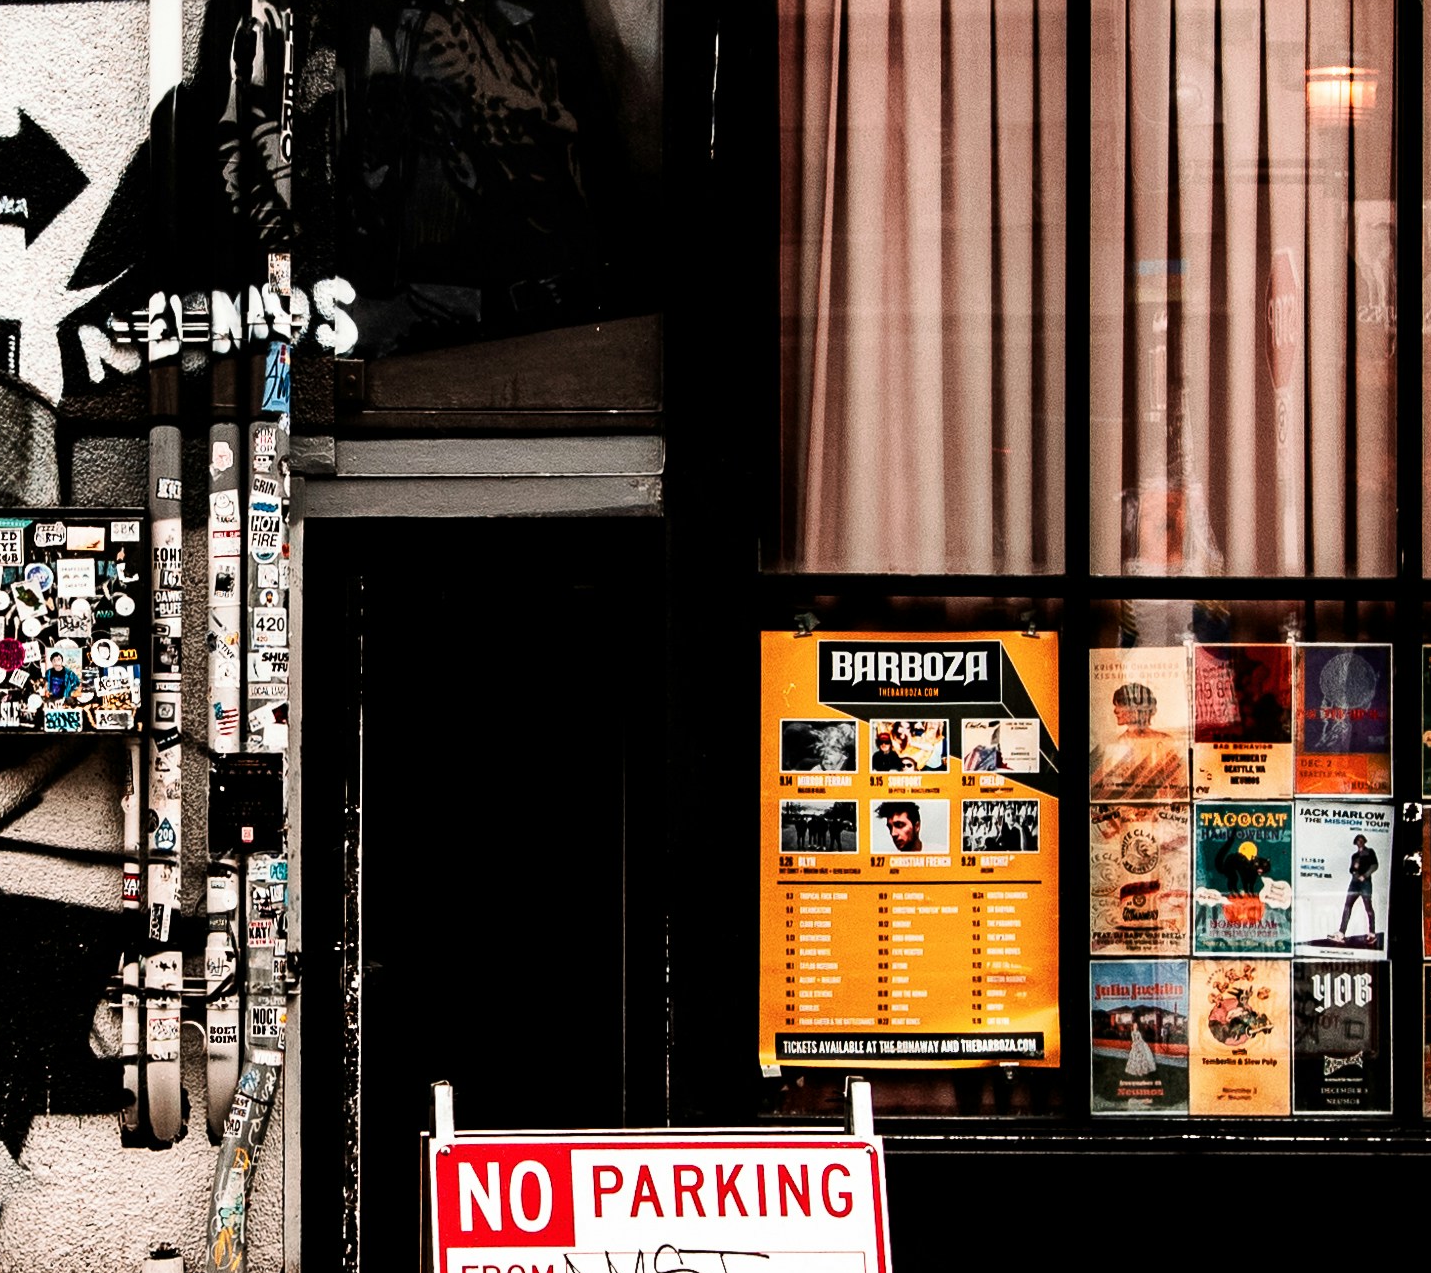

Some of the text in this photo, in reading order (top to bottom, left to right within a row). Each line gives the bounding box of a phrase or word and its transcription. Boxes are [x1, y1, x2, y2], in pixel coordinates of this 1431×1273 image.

[253, 477, 277, 496] GRIN
[251, 516, 280, 532] HOT
[251, 533, 278, 548] FIRE
[256, 617, 285, 633] 420
[830, 650, 988, 687] BARBOZA
[877, 687, 940, 698] THEBARBOZA.COM
[1299, 808, 1386, 821] JACK HARLOW
[1324, 818, 1363, 826] MISSION
[1365, 820, 1391, 828] TOUR
[252, 1007, 279, 1025] NOCT
[783, 1040, 817, 1054] TICKETS
[818, 1040, 865, 1054] AVAILABLE
[866, 1040, 878, 1054] AT
[941, 1039, 959, 1053] AND
[457, 1159, 854, 1233] NO PARKING
